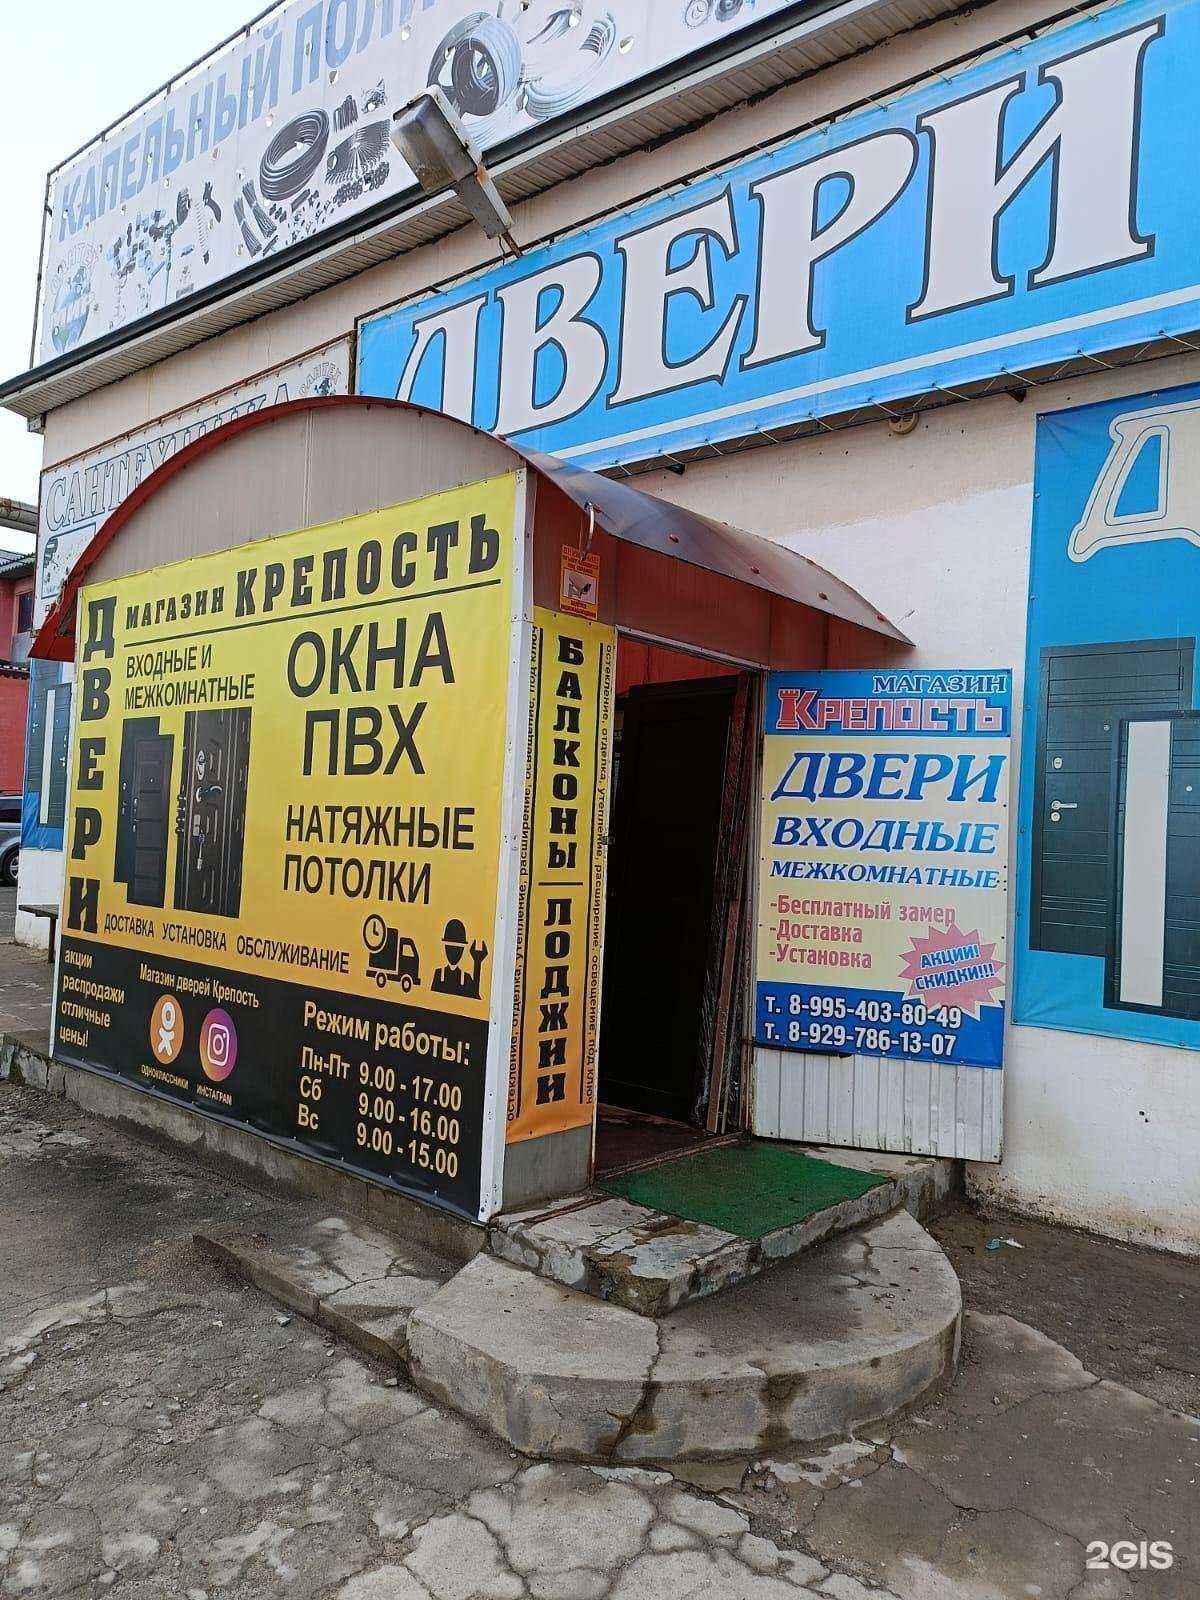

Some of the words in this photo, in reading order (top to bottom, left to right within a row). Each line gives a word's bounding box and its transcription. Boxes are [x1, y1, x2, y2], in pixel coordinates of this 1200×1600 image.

[57, 17, 284, 243] КАПЕЛЬНЫЙ
[395, 15, 1166, 439] ДВЕРИ
[125, 586, 225, 630] МАГАЗИН
[234, 513, 501, 618] КРЕПОСТЬ
[125, 645, 197, 680] ВХОДНЫЕ
[200, 643, 212, 669] И
[286, 611, 456, 698] ОКНА
[124, 673, 256, 711] МЕЖКОМНАТНЫЕ
[872, 674, 1007, 694] МАГАЗИН
[302, 701, 428, 776] ПВХ
[547, 634, 585, 869] БАЛКОНЫ
[67, 596, 118, 935] ДВЕРИ
[771, 751, 1008, 804] ДВЕРИ
[285, 804, 476, 851] НАТЯЖНЫЕ
[772, 815, 1000, 855] ВХОДНЫЕ
[283, 853, 432, 905] ПОТОЛКИ
[769, 860, 1000, 889] МЕЖКОМНАТНЫЕ
[898, 903, 956, 925] замер
[64, 948, 93, 970] акции
[104, 911, 154, 939] ДОСТАВКА
[162, 921, 227, 952] УСТАНОВКА
[236, 933, 351, 975] ОБСЛУЖИВАНИЕ
[919, 944, 981, 970] АКЦИИ!
[62, 975, 126, 1005] распродажи
[139, 962, 175, 988] Магазин
[176, 976, 210, 997] дверей
[212, 979, 260, 1008] Крепость
[914, 962, 995, 991] СКИДКИ!!!
[60, 1003, 111, 1029] отличные
[535, 898, 573, 1106] ЛОДЖИИ
[788, 993, 963, 1030] 8-995-403-80-49
[59, 1026, 89, 1050] цены!
[303, 1000, 370, 1043] Режим
[374, 1019, 471, 1067] работы:
[788, 1019, 957, 1057] 8-929-786-13-07
[300, 1046, 351, 1081] Пн-Пт
[359, 1061, 395, 1093] 9.00
[411, 1075, 463, 1113] 17.00
[299, 1075, 322, 1101] Сб
[357, 1093, 394, 1125] 9.00
[409, 1108, 461, 1146] 16.00
[298, 1103, 320, 1131] Вс
[356, 1121, 393, 1157] 9.00
[407, 1140, 459, 1180] 15.00
